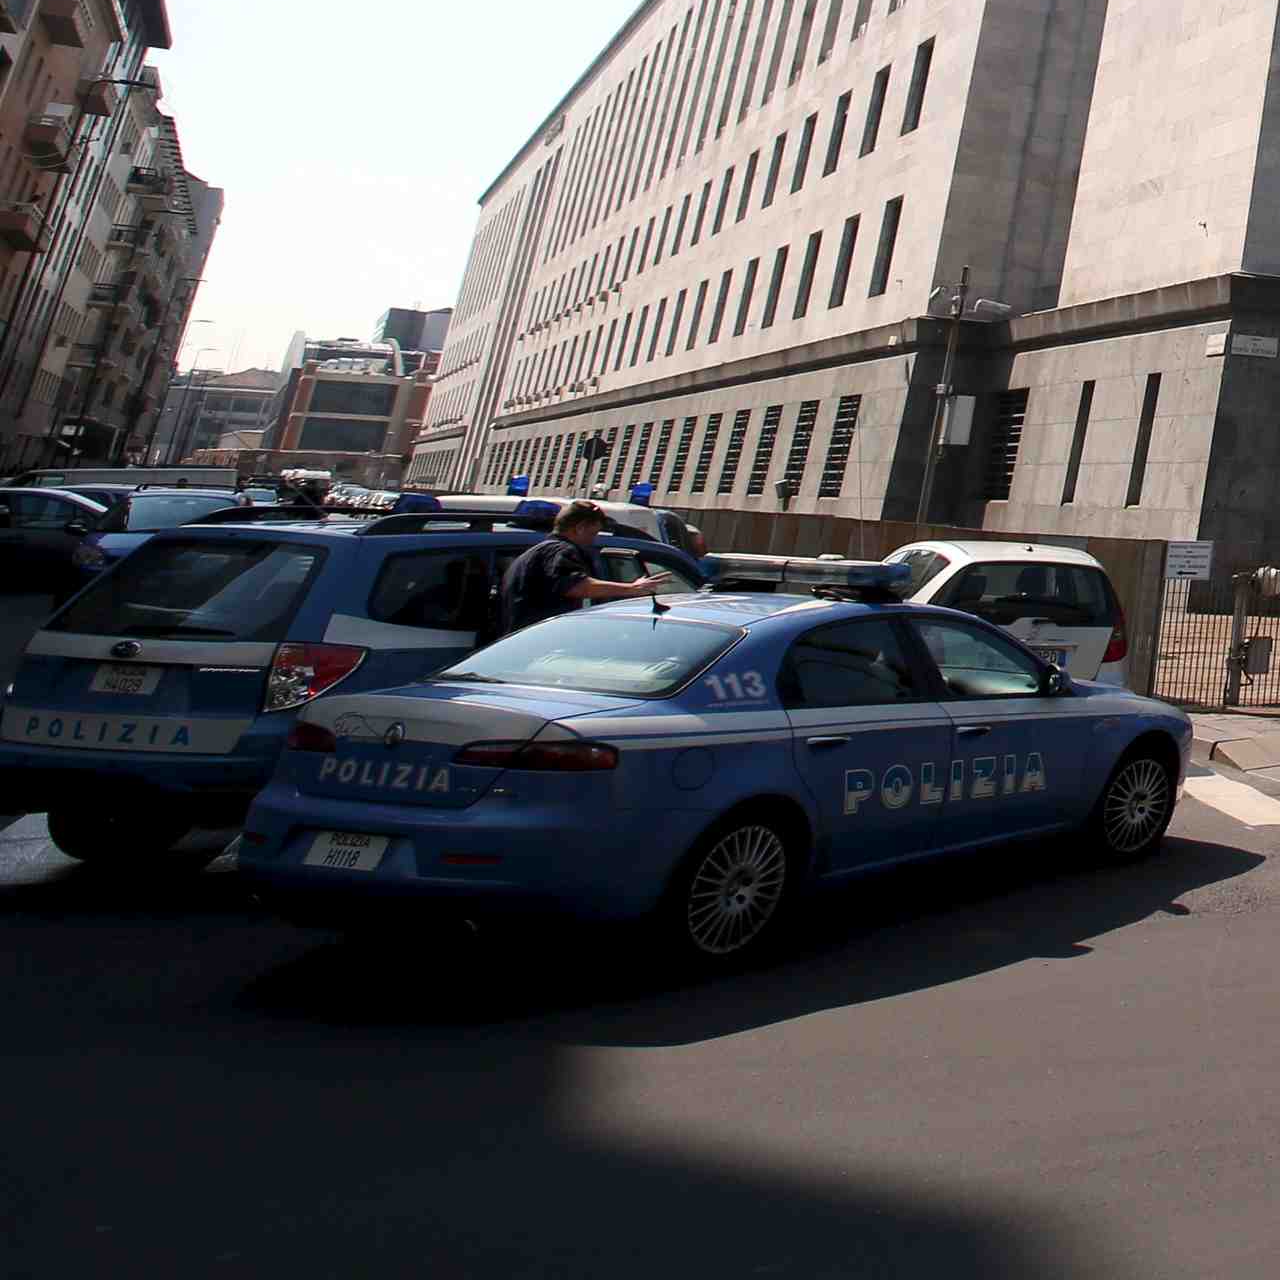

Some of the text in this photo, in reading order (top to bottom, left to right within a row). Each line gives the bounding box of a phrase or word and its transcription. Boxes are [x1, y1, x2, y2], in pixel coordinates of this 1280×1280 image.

[703, 671, 768, 700] 113
[25, 716, 191, 747] POLIZIA
[319, 756, 451, 793] POLIZIA
[843, 751, 1047, 815] POLIZIA
